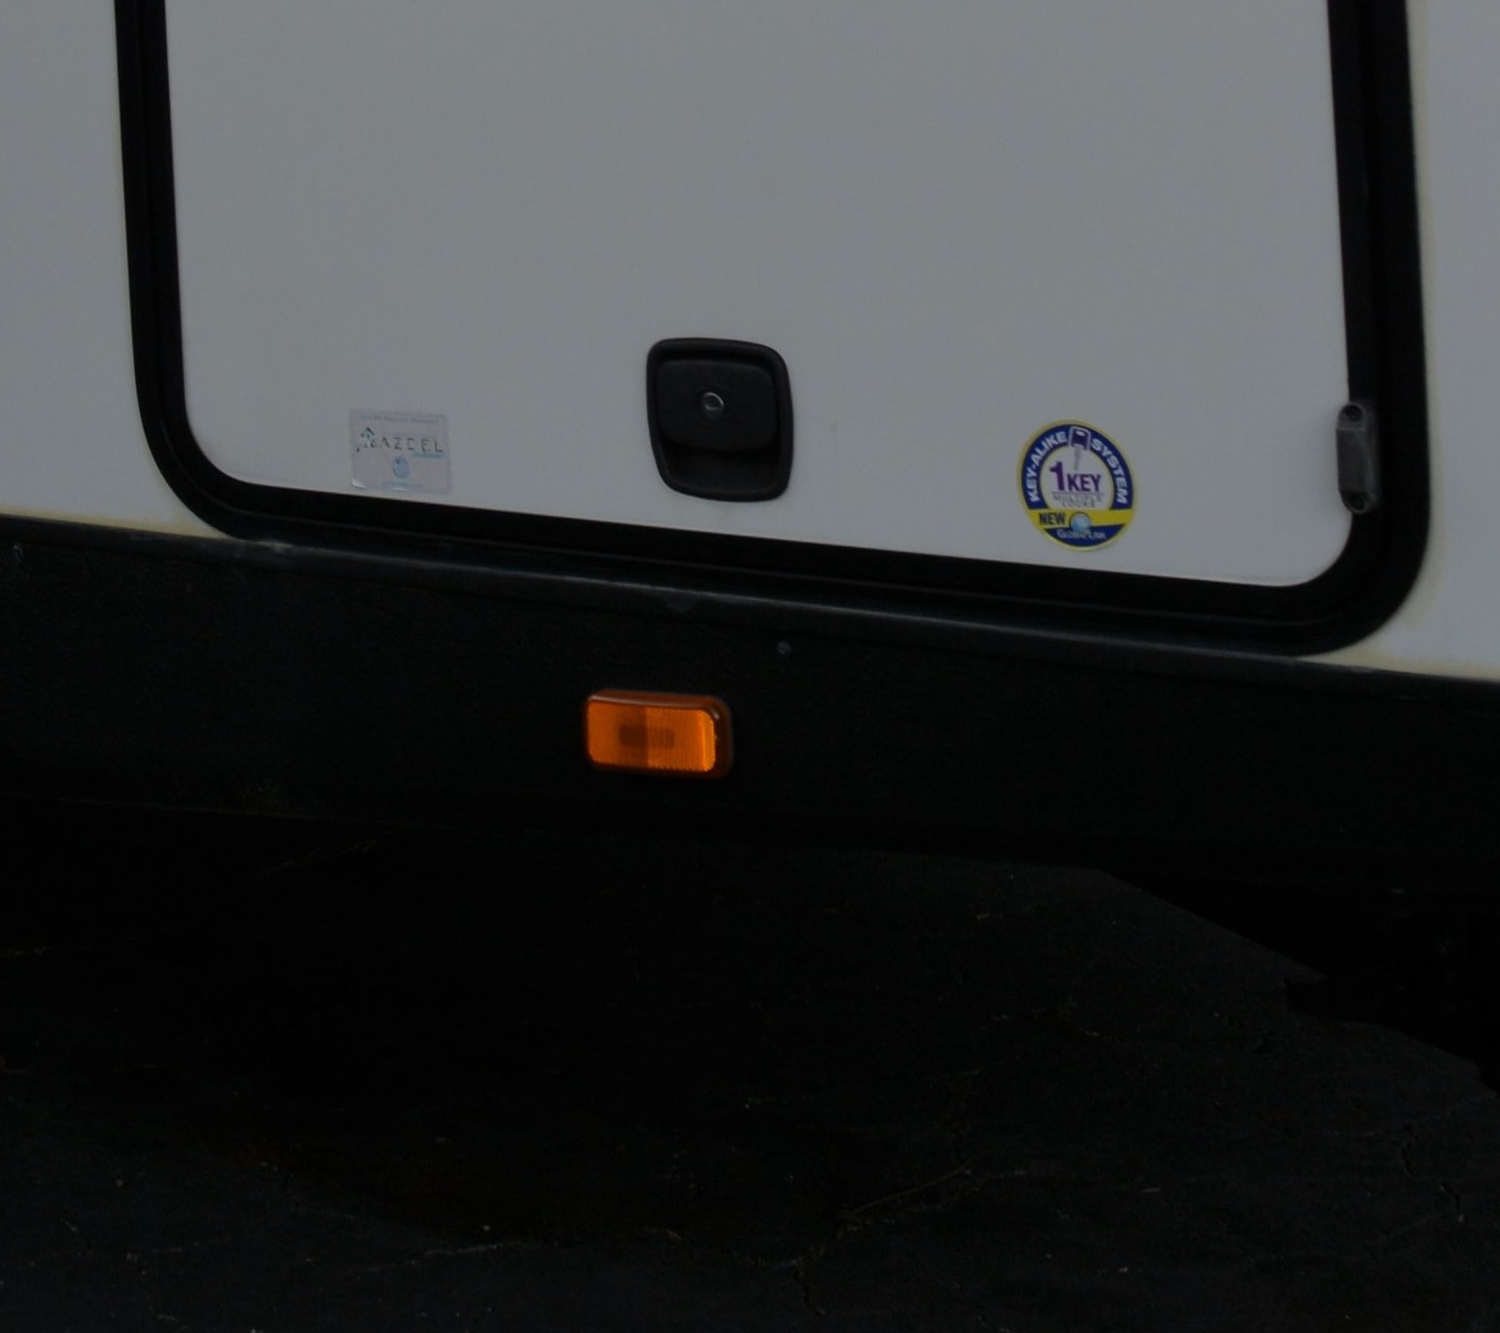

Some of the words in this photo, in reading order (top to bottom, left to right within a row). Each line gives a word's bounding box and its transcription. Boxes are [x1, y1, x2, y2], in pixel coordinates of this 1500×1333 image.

[1049, 461, 1065, 492] 1
[1067, 474, 1101, 492] KEY
[1091, 438, 1128, 504] SYSTEM
[1039, 513, 1066, 526] NEW
